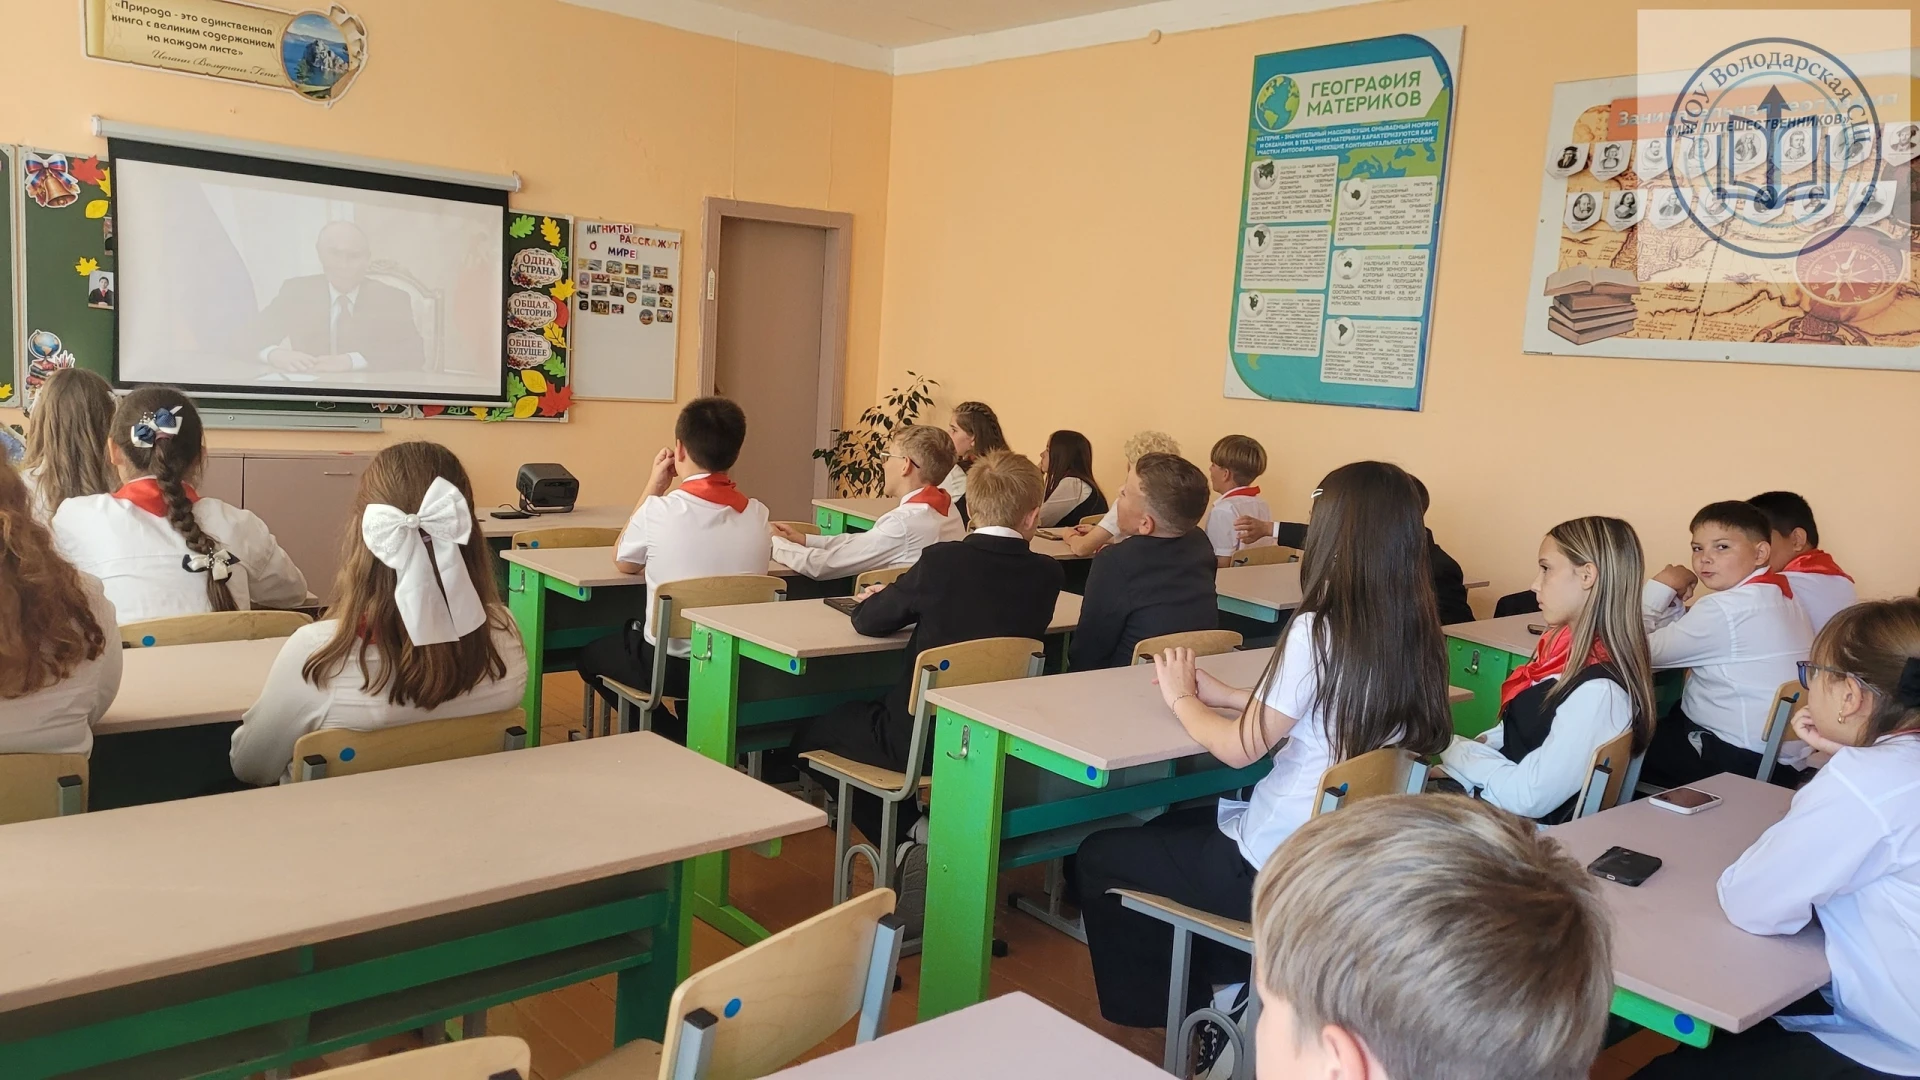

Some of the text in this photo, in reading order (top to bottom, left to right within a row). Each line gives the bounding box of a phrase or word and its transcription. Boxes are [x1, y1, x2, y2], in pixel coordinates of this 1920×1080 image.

[115, 0, 171, 18] «Природа
[181, 13, 198, 22] это
[201, 16, 272, 36] единственная
[112, 15, 275, 49] книга с великим содержанием
[147, 34, 243, 56] на каждом листе»
[1311, 70, 1421, 98] ГЕОГРАФИЯ
[1307, 90, 1421, 117] МАТЕРИКОВ
[620, 235, 679, 250] РАССКАЖУТ
[608, 246, 637, 259] МИРЕ
[523, 254, 553, 266] ОДНА
[519, 264, 556, 276] СТРАНА
[514, 299, 548, 309] ОБЩАЯ
[514, 308, 552, 317] ИСТОРИЯ
[509, 339, 543, 348] ОБЩЕЕ
[508, 348, 547, 356] БУДУЩЕЕ
